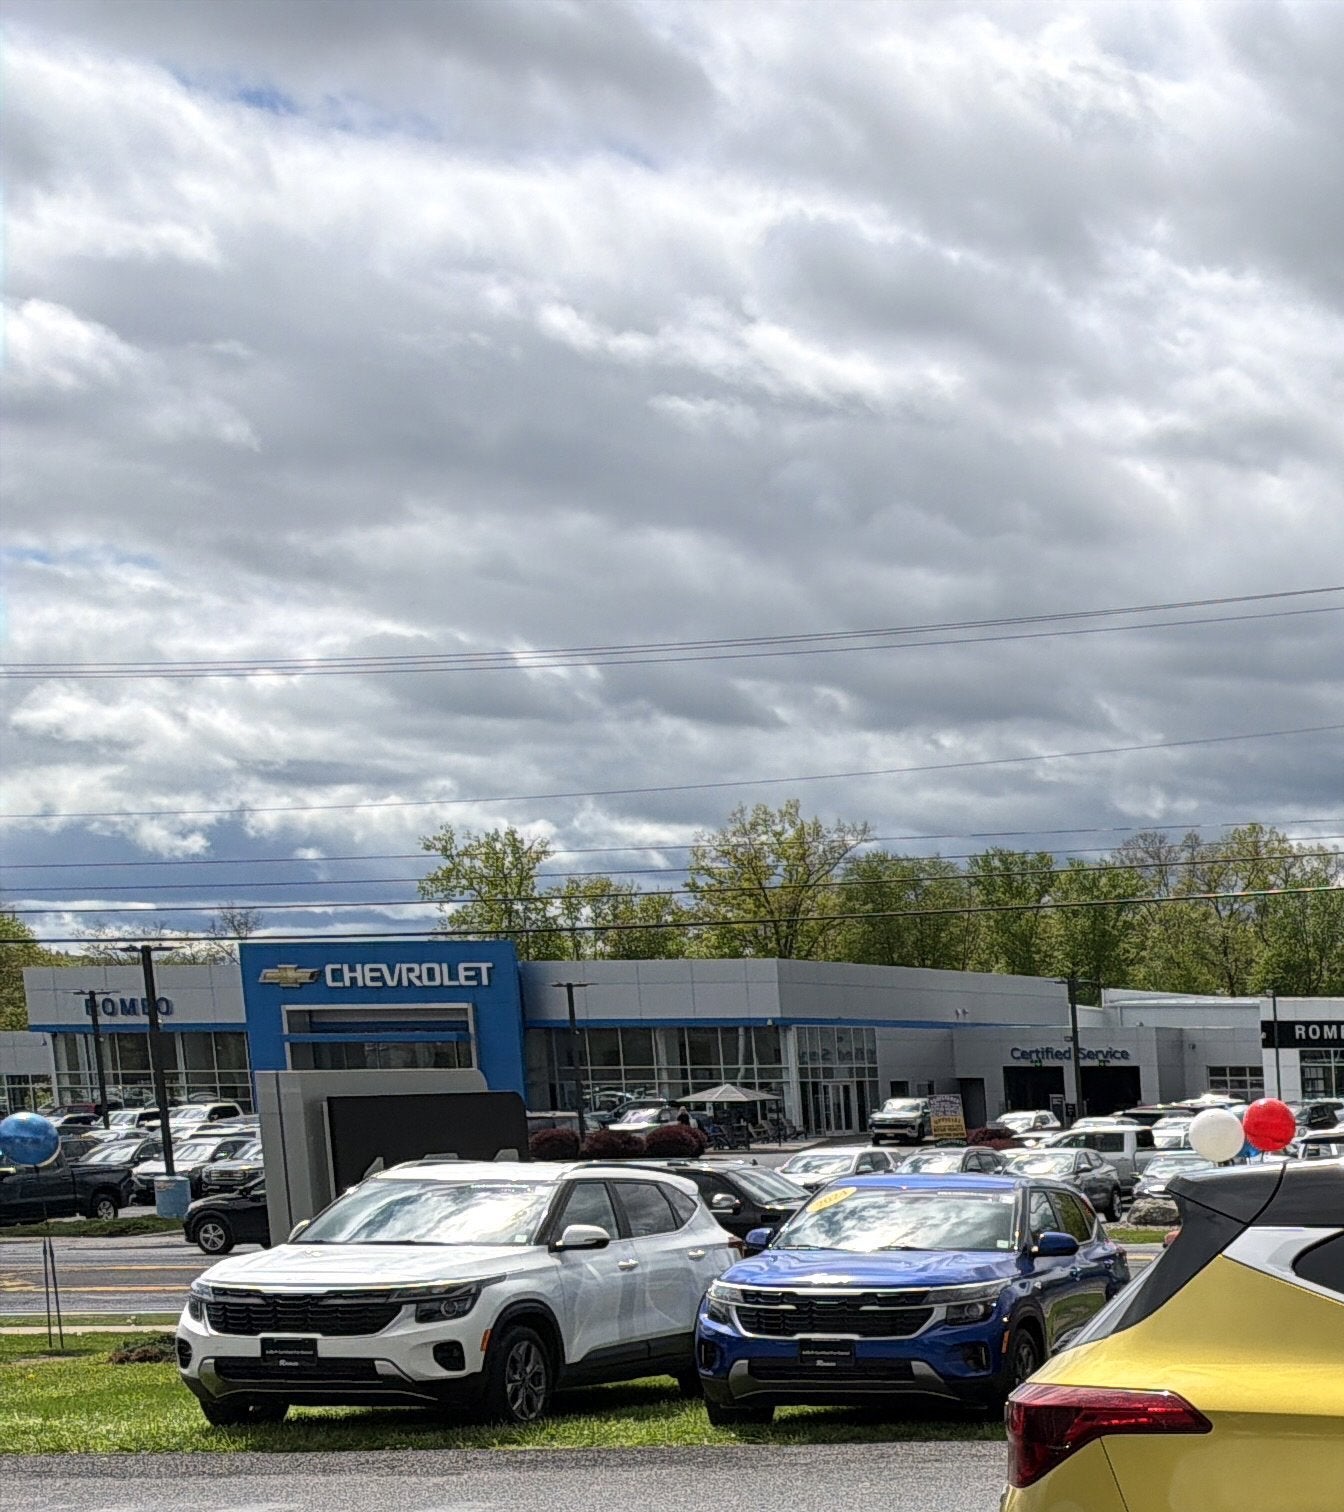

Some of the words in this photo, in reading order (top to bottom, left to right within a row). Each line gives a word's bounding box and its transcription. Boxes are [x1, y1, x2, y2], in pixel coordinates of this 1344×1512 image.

[324, 961, 494, 988] CHEVROLET
[1010, 1046, 1073, 1061] Certified
[1078, 1046, 1131, 1061] Service
